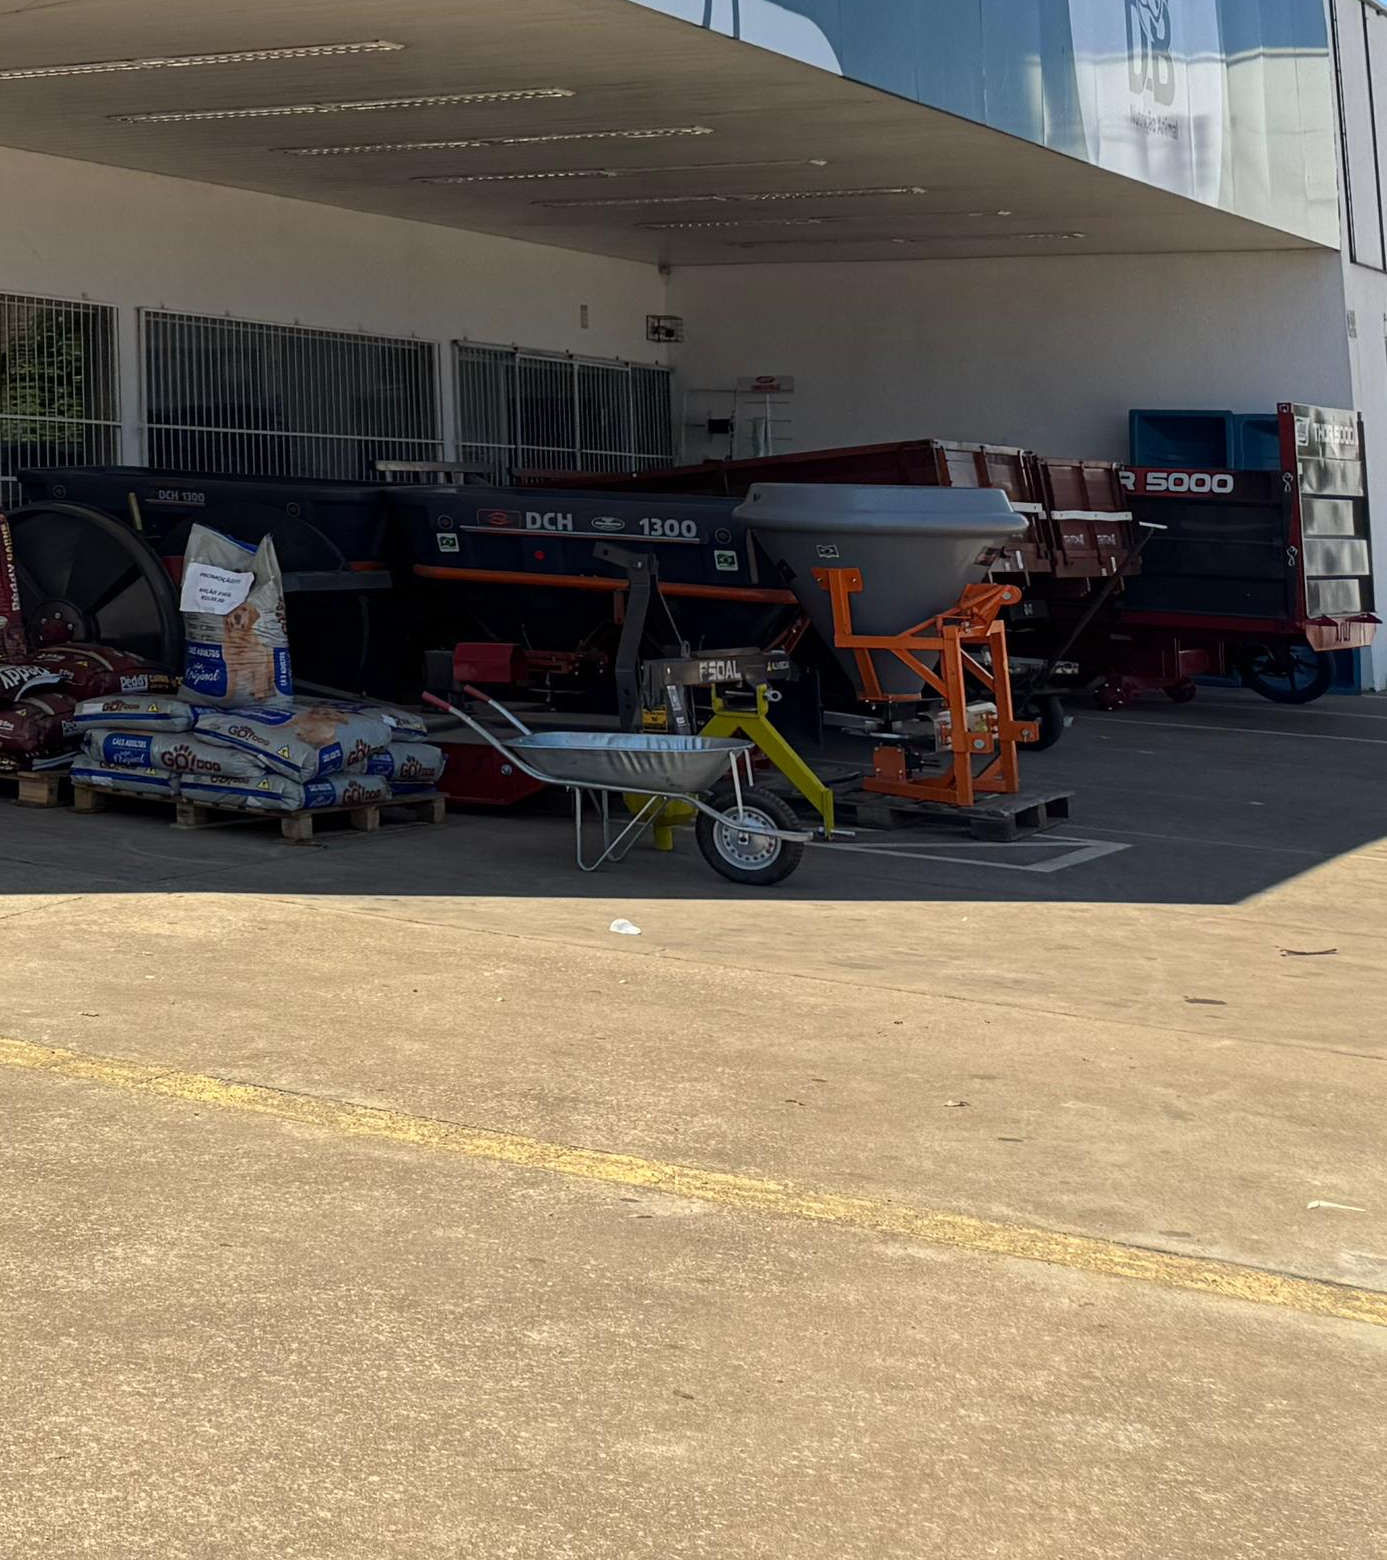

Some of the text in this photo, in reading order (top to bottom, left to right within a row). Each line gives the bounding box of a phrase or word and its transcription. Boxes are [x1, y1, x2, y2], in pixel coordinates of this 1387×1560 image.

[1146, 471, 1235, 494] 5000
[158, 489, 206, 502] DCH 1300
[525, 511, 698, 538] DCH 1300
